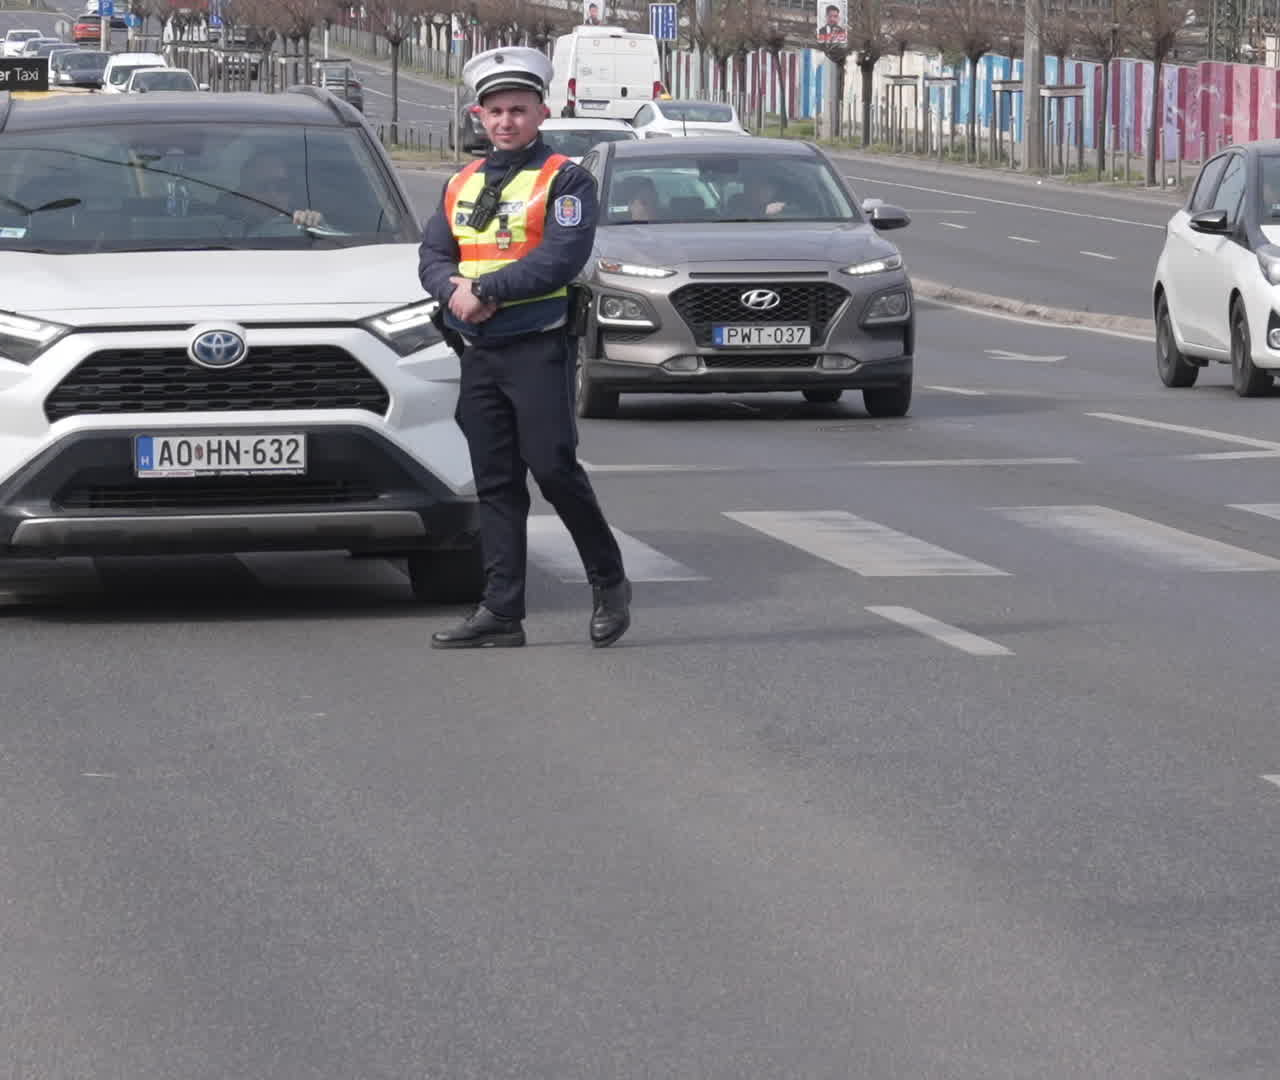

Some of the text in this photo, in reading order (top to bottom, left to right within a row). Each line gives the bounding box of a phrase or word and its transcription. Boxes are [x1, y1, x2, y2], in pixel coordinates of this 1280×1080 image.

[13, 67, 40, 81] Taxi
[727, 327, 806, 344] PWT-037
[206, 438, 302, 466] HN-632
[140, 455, 150, 466] H
